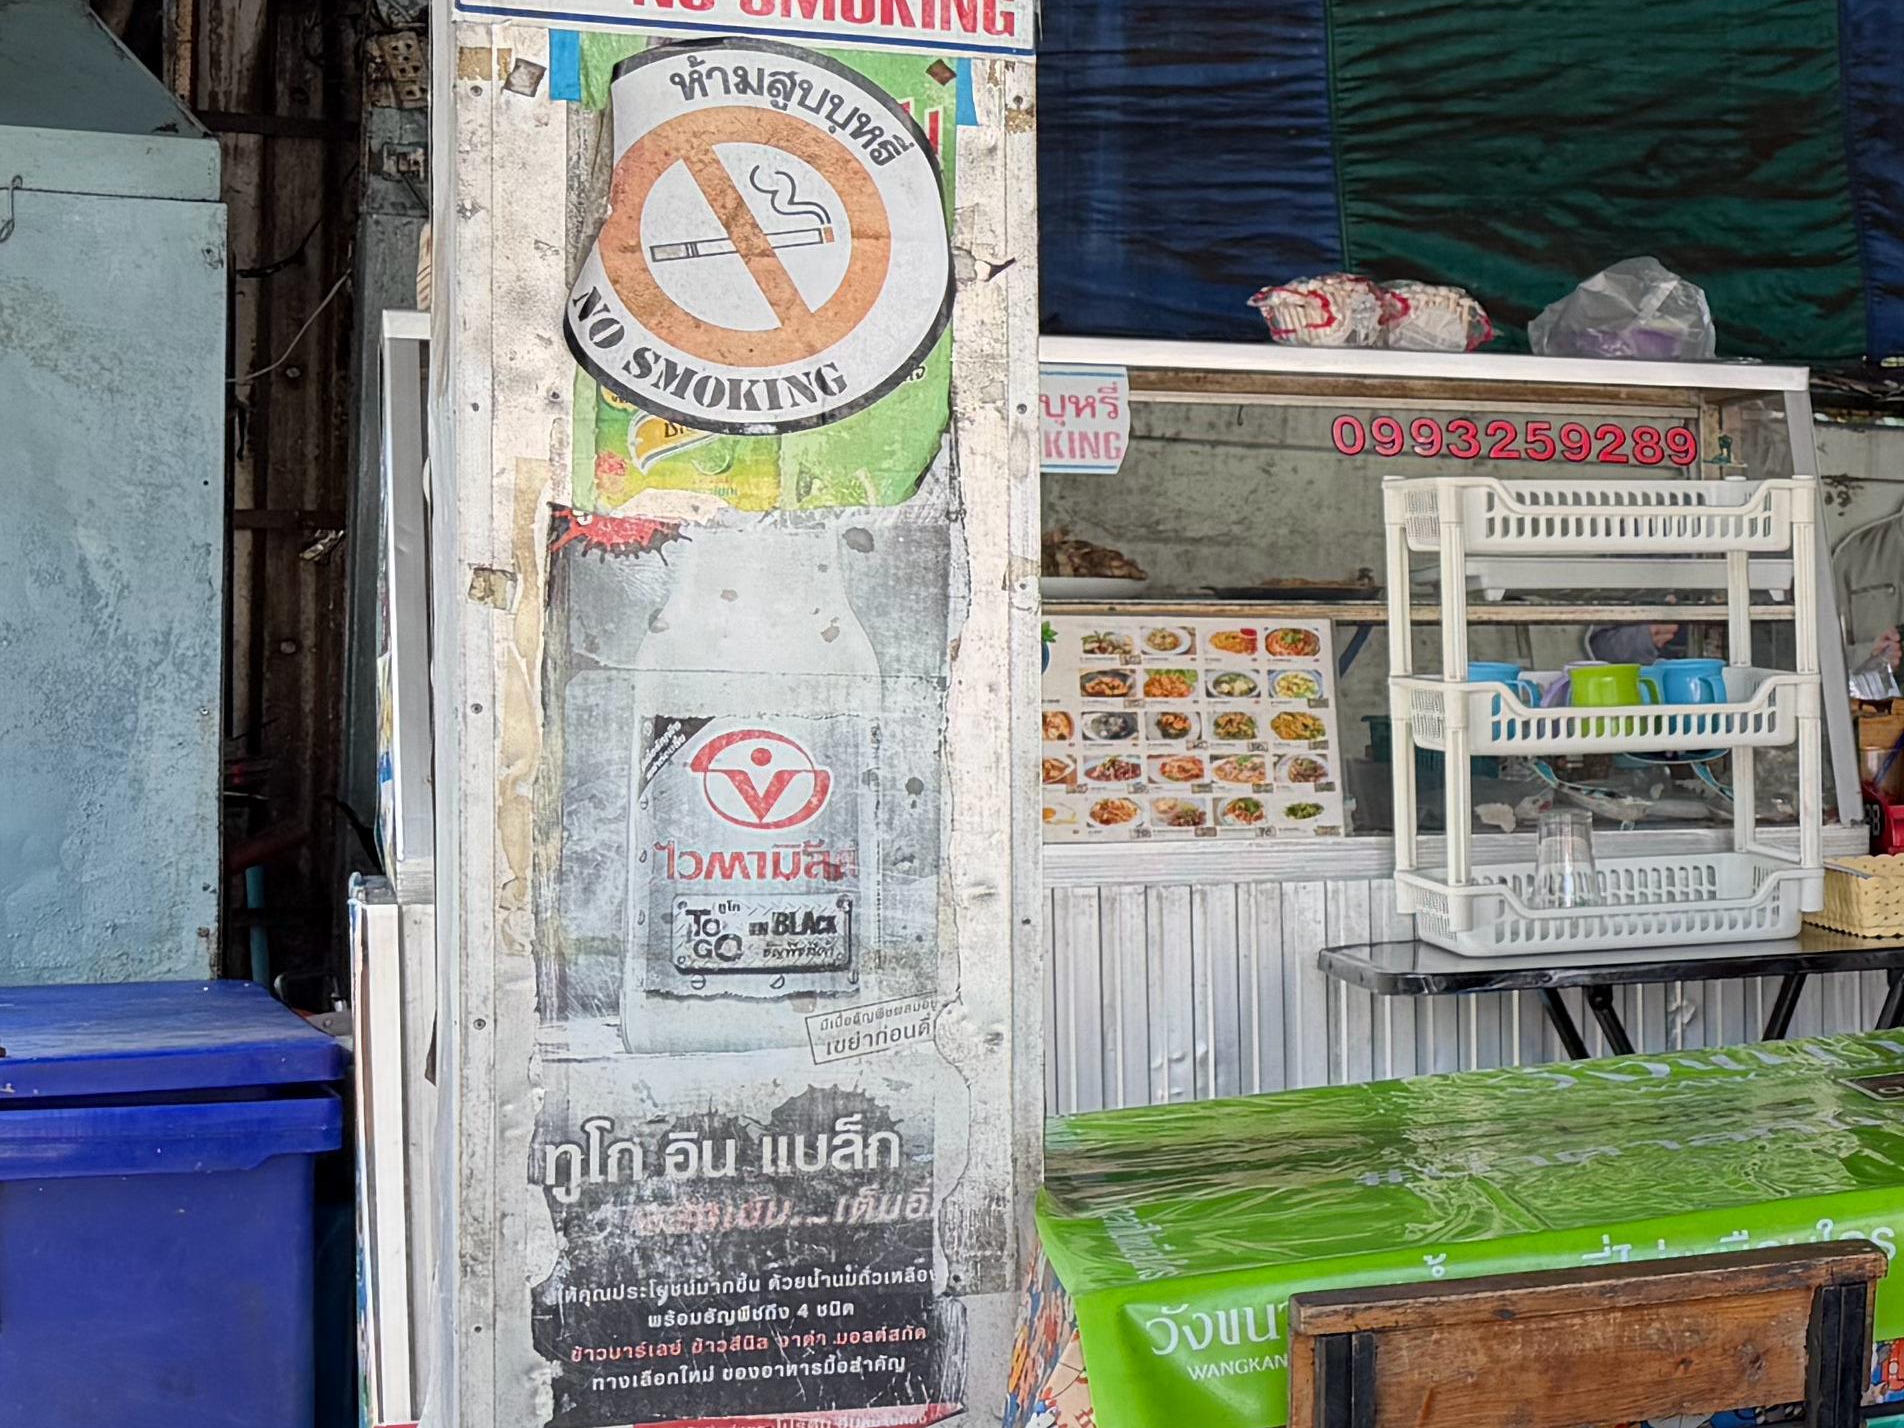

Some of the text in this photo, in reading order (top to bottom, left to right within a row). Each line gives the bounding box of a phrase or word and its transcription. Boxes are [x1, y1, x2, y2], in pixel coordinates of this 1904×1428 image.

[670, 55, 915, 168] ห้ามสูบบุหรี่
[571, 284, 848, 412] NO SMOKING
[1331, 412, 1698, 467] 0993259289
[771, 910, 838, 936] BLACK
[665, 1132, 737, 1178] อิน
[762, 1114, 899, 1179] แบล็ก
[796, 1305, 810, 1320] 4
[816, 1300, 855, 1319] ชนิด
[592, 1364, 715, 1392] ทางเลือกใหม่
